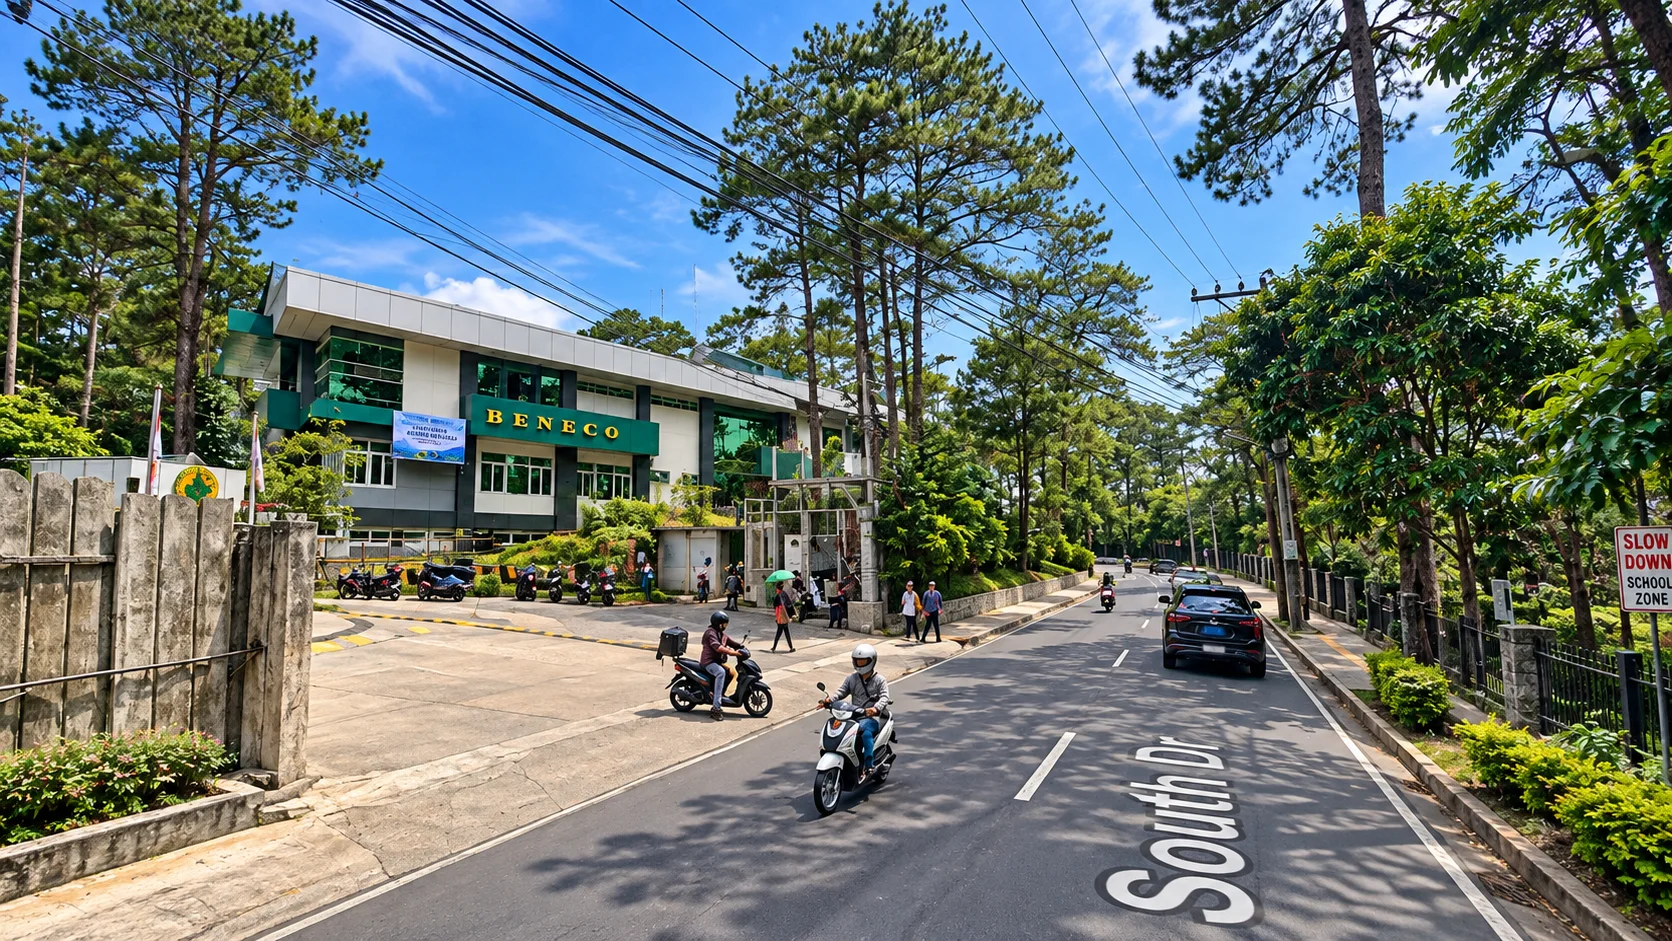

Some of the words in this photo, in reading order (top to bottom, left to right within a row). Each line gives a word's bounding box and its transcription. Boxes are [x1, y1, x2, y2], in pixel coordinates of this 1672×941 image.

[486, 408, 619, 439] BENECO
[1623, 533, 1669, 550] SLOW
[1625, 554, 1672, 570] DOWN
[1627, 576, 1672, 589] SCHOOL
[1635, 593, 1669, 605] ZONE
